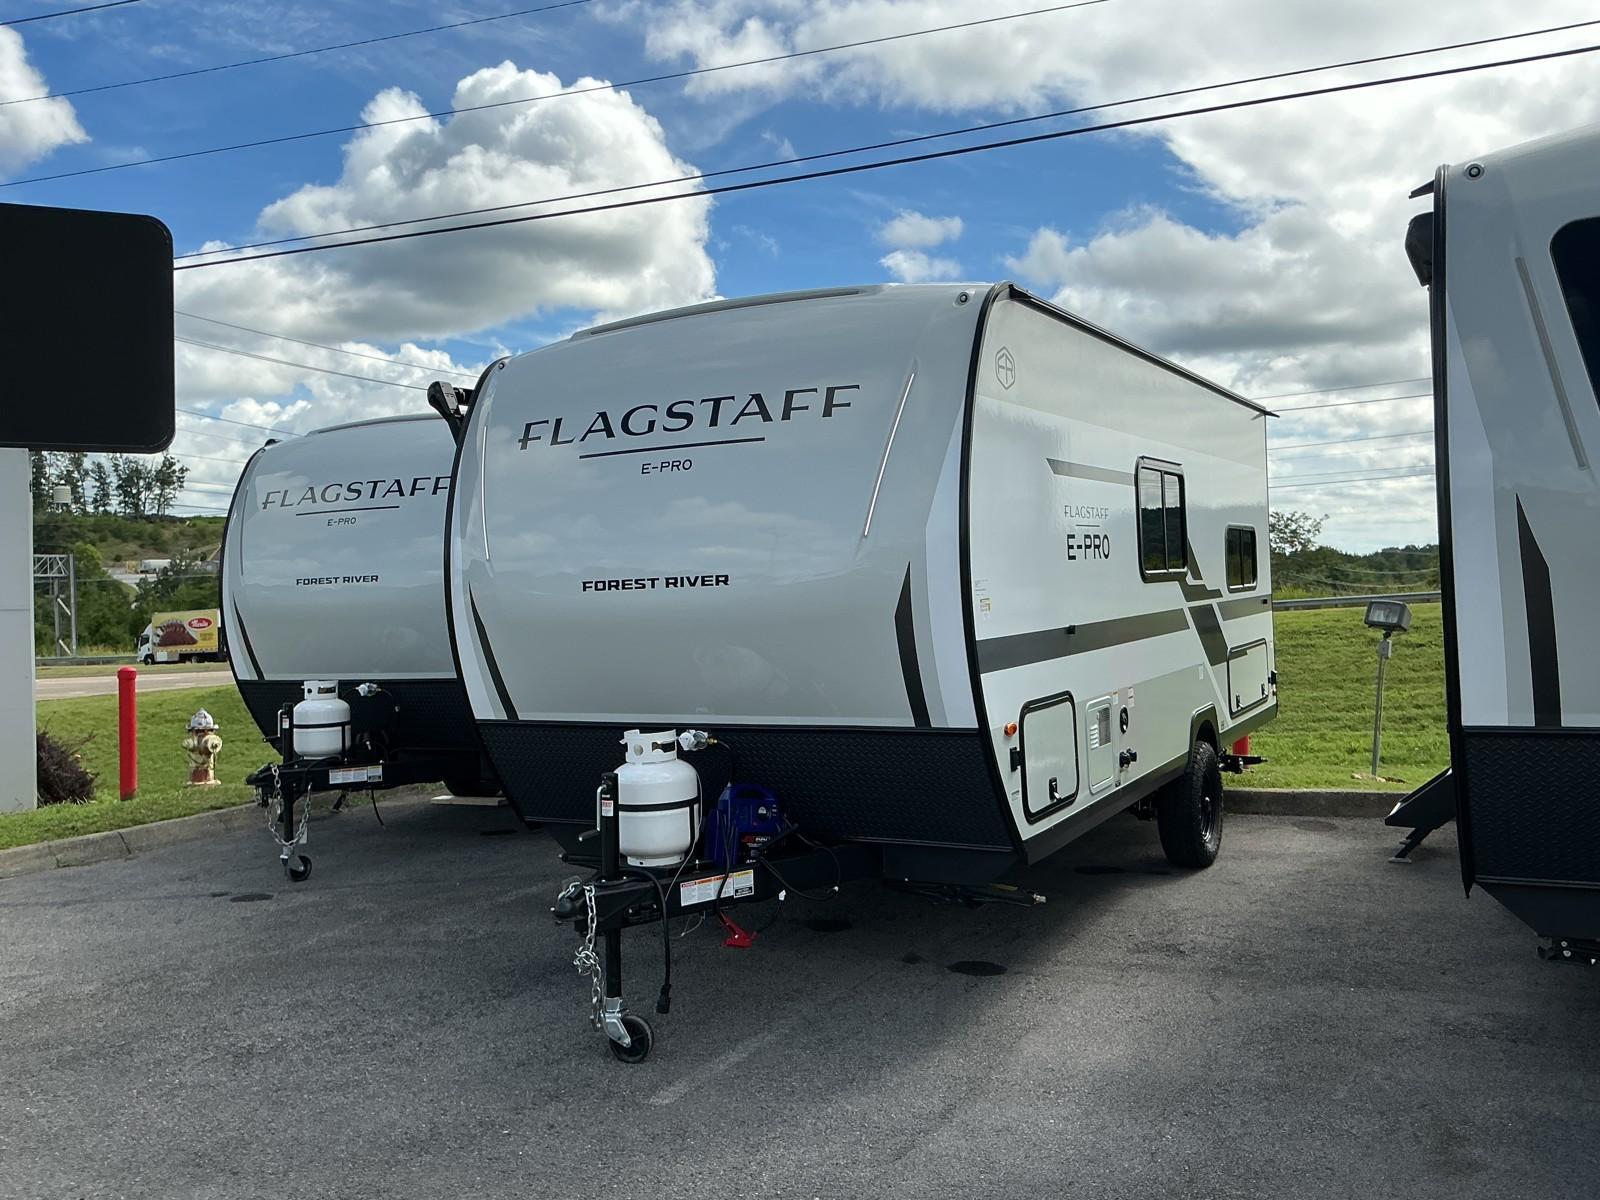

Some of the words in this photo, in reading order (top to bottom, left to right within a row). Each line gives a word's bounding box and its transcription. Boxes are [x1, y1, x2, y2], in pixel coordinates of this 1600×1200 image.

[518, 384, 860, 451] FLAGSTAFF
[641, 459, 693, 475] E-PRO
[262, 476, 451, 510] FLAGSTAFF
[1064, 504, 1110, 520] FLAGSTAFF
[327, 517, 357, 527] E-PRO
[1066, 533, 1110, 561] E-PRO
[296, 576, 340, 586] FOREST
[342, 575, 379, 584] RIVER
[582, 577, 660, 592] FOREST
[664, 574, 730, 589] RIVER
